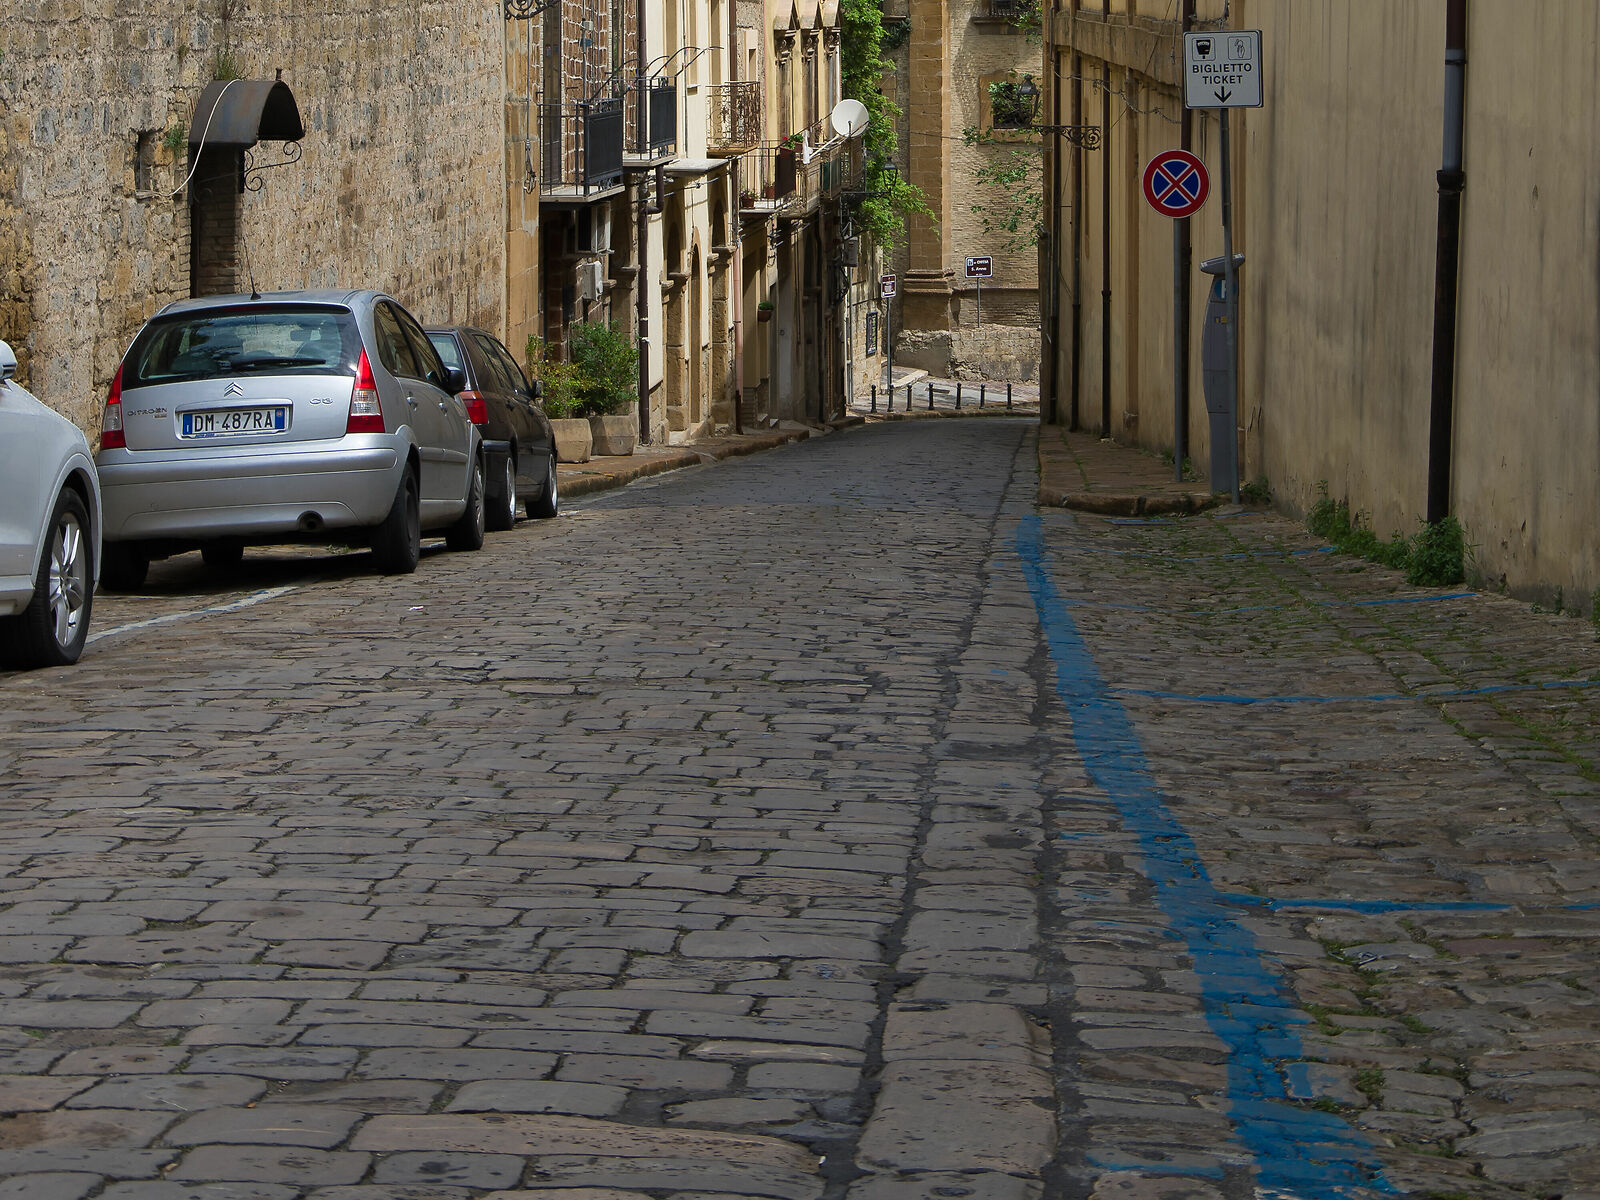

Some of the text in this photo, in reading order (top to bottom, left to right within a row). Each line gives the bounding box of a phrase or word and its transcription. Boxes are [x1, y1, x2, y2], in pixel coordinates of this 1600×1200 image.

[1192, 63, 1252, 73] BIGLIETTO
[1202, 75, 1243, 84] TICKET
[222, 411, 273, 431] 487RA
